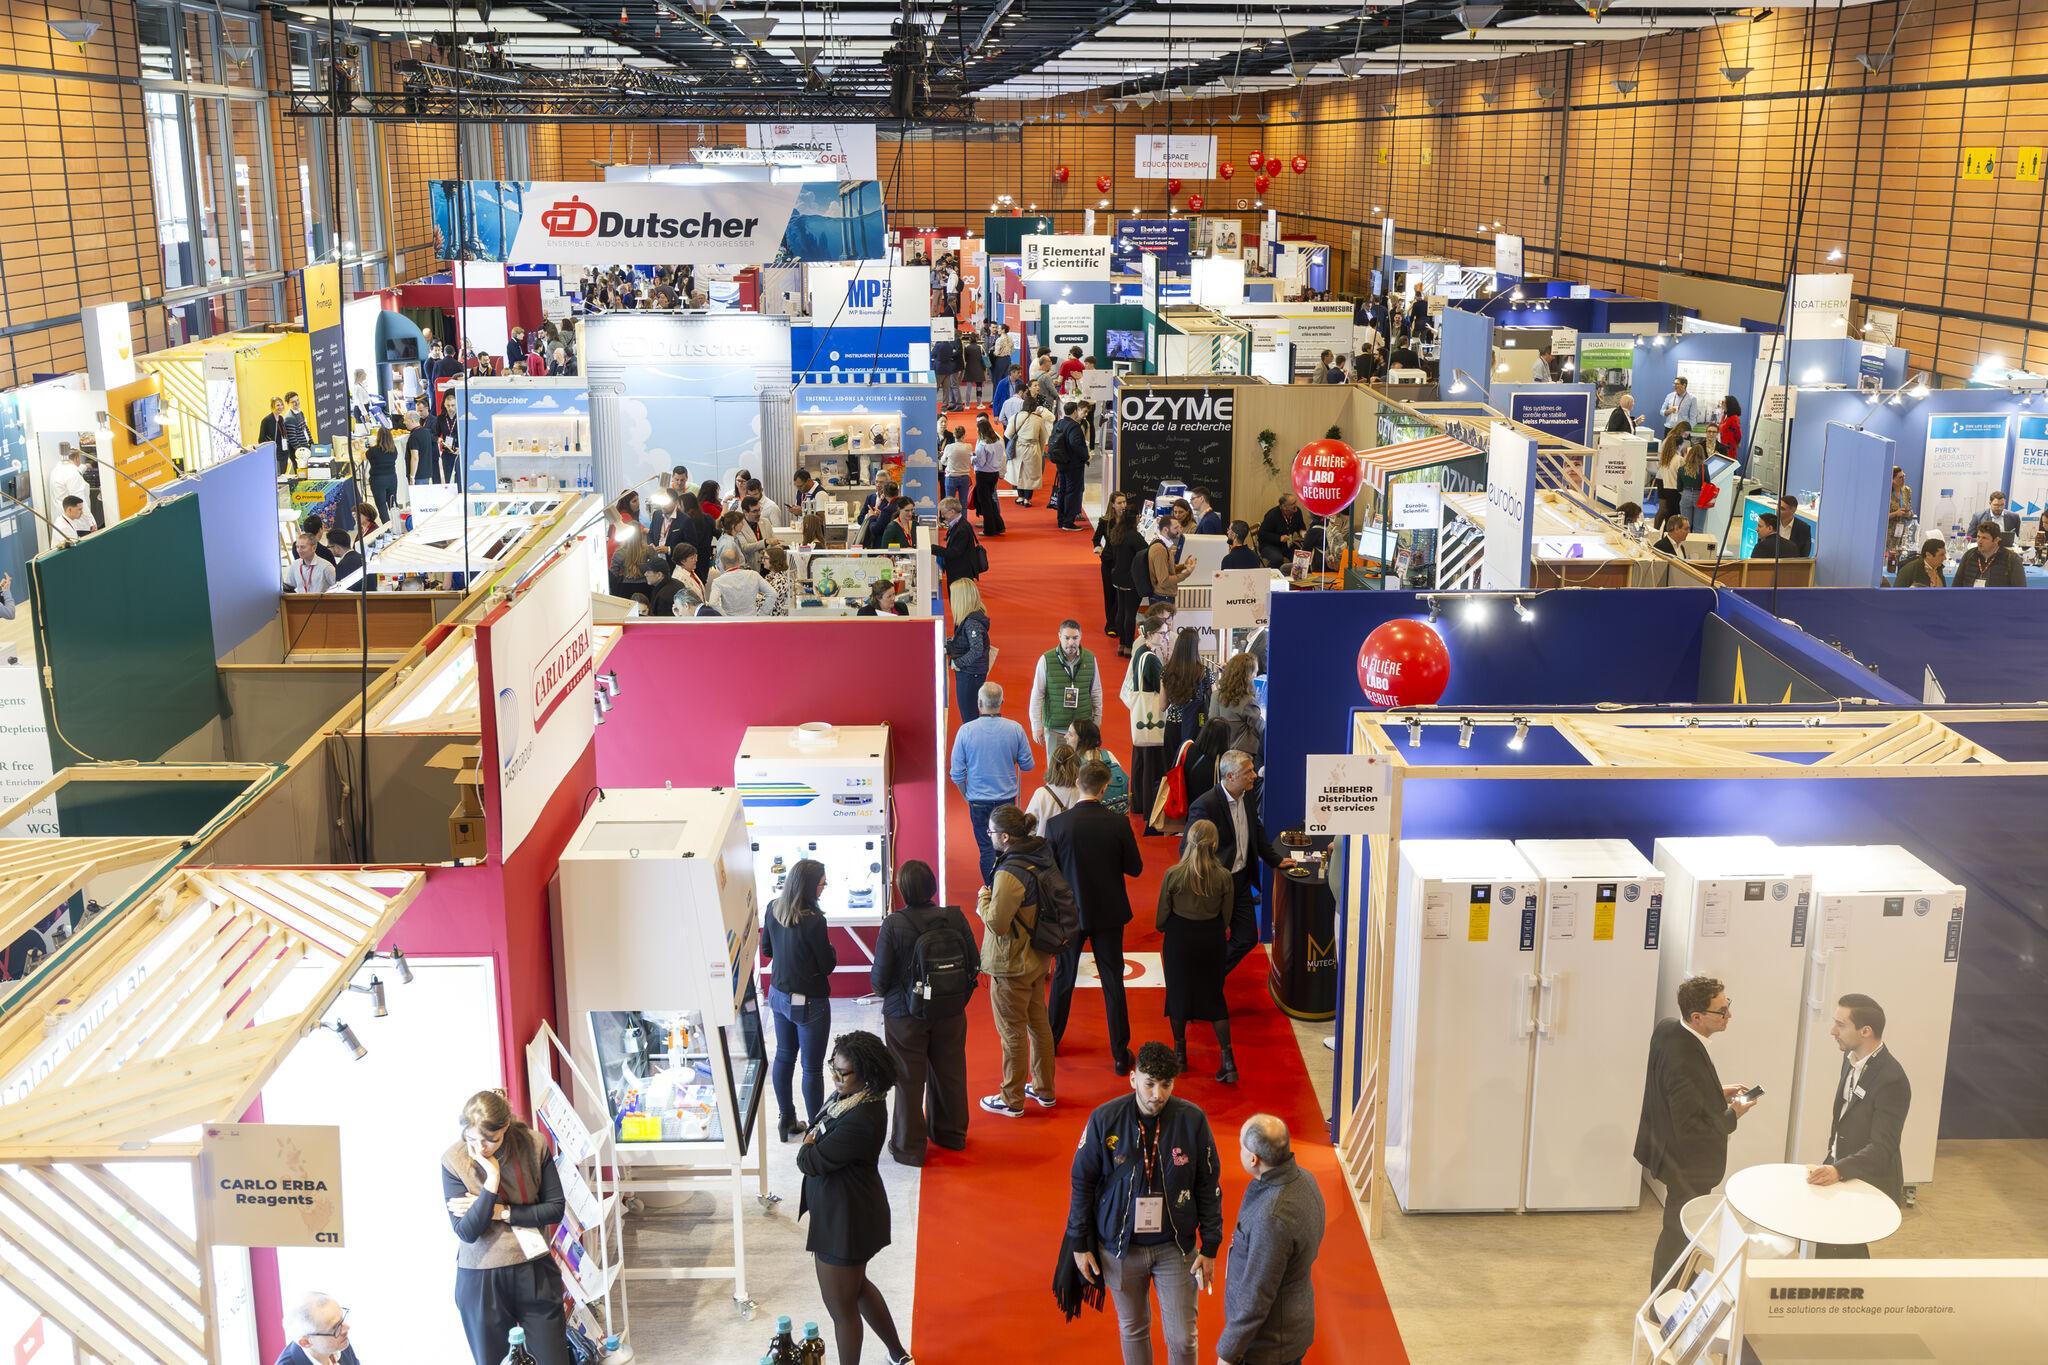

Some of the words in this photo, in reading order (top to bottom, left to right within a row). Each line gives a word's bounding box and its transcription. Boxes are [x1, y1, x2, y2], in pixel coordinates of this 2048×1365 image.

[598, 211, 759, 239] Dutscher
[1042, 246, 1106, 257] Elemental
[1042, 257, 1100, 268] Scientific
[848, 279, 881, 308] MP
[316, 299, 333, 310] Promega
[1312, 305, 1353, 313] MANUMESURE
[1793, 299, 1848, 309] RIGATHERM
[486, 396, 529, 404] Dutscher
[1121, 396, 1233, 421] OZYME
[1121, 422, 1150, 432] Place
[1152, 422, 1165, 431] de
[1167, 422, 1179, 431] la
[1180, 422, 1232, 431] recherche
[1302, 455, 1313, 467] LA
[1313, 453, 1346, 468] FILIÈRE
[1933, 461, 1974, 469] GLASSWARE
[1308, 470, 1335, 484] LABO
[1303, 486, 1341, 500] RECRUTE
[1488, 482, 1523, 522] eurobio
[1226, 598, 1256, 606] MUTECH
[535, 654, 565, 707] CARLO
[565, 628, 590, 672] ERBA
[1361, 654, 1369, 669] LA
[1368, 655, 1402, 676] FILIÈRE
[1366, 674, 1389, 691] LABO
[12, 761, 34, 771] free
[1323, 786, 1373, 794] LIEBHERR
[1318, 795, 1378, 803] Distribution
[1321, 804, 1332, 812] et
[1333, 804, 1375, 812] services
[27, 823, 59, 834] WGS
[1309, 824, 1327, 832] C10
[1307, 958, 1336, 968] MUTECH
[220, 1178, 277, 1192] CARLO
[282, 1179, 328, 1192] ERBA
[235, 1193, 314, 1207] Reagents
[315, 1232, 339, 1244] C11
[1770, 1287, 1865, 1300] LIEBHERR
[1768, 1305, 1784, 1314] Les
[1786, 1305, 1827, 1314] solutions
[1828, 1305, 1840, 1314] de
[1842, 1305, 1882, 1316] stockage
[1884, 1306, 1904, 1315] pour
[1906, 1305, 1956, 1314] laboratoire.
